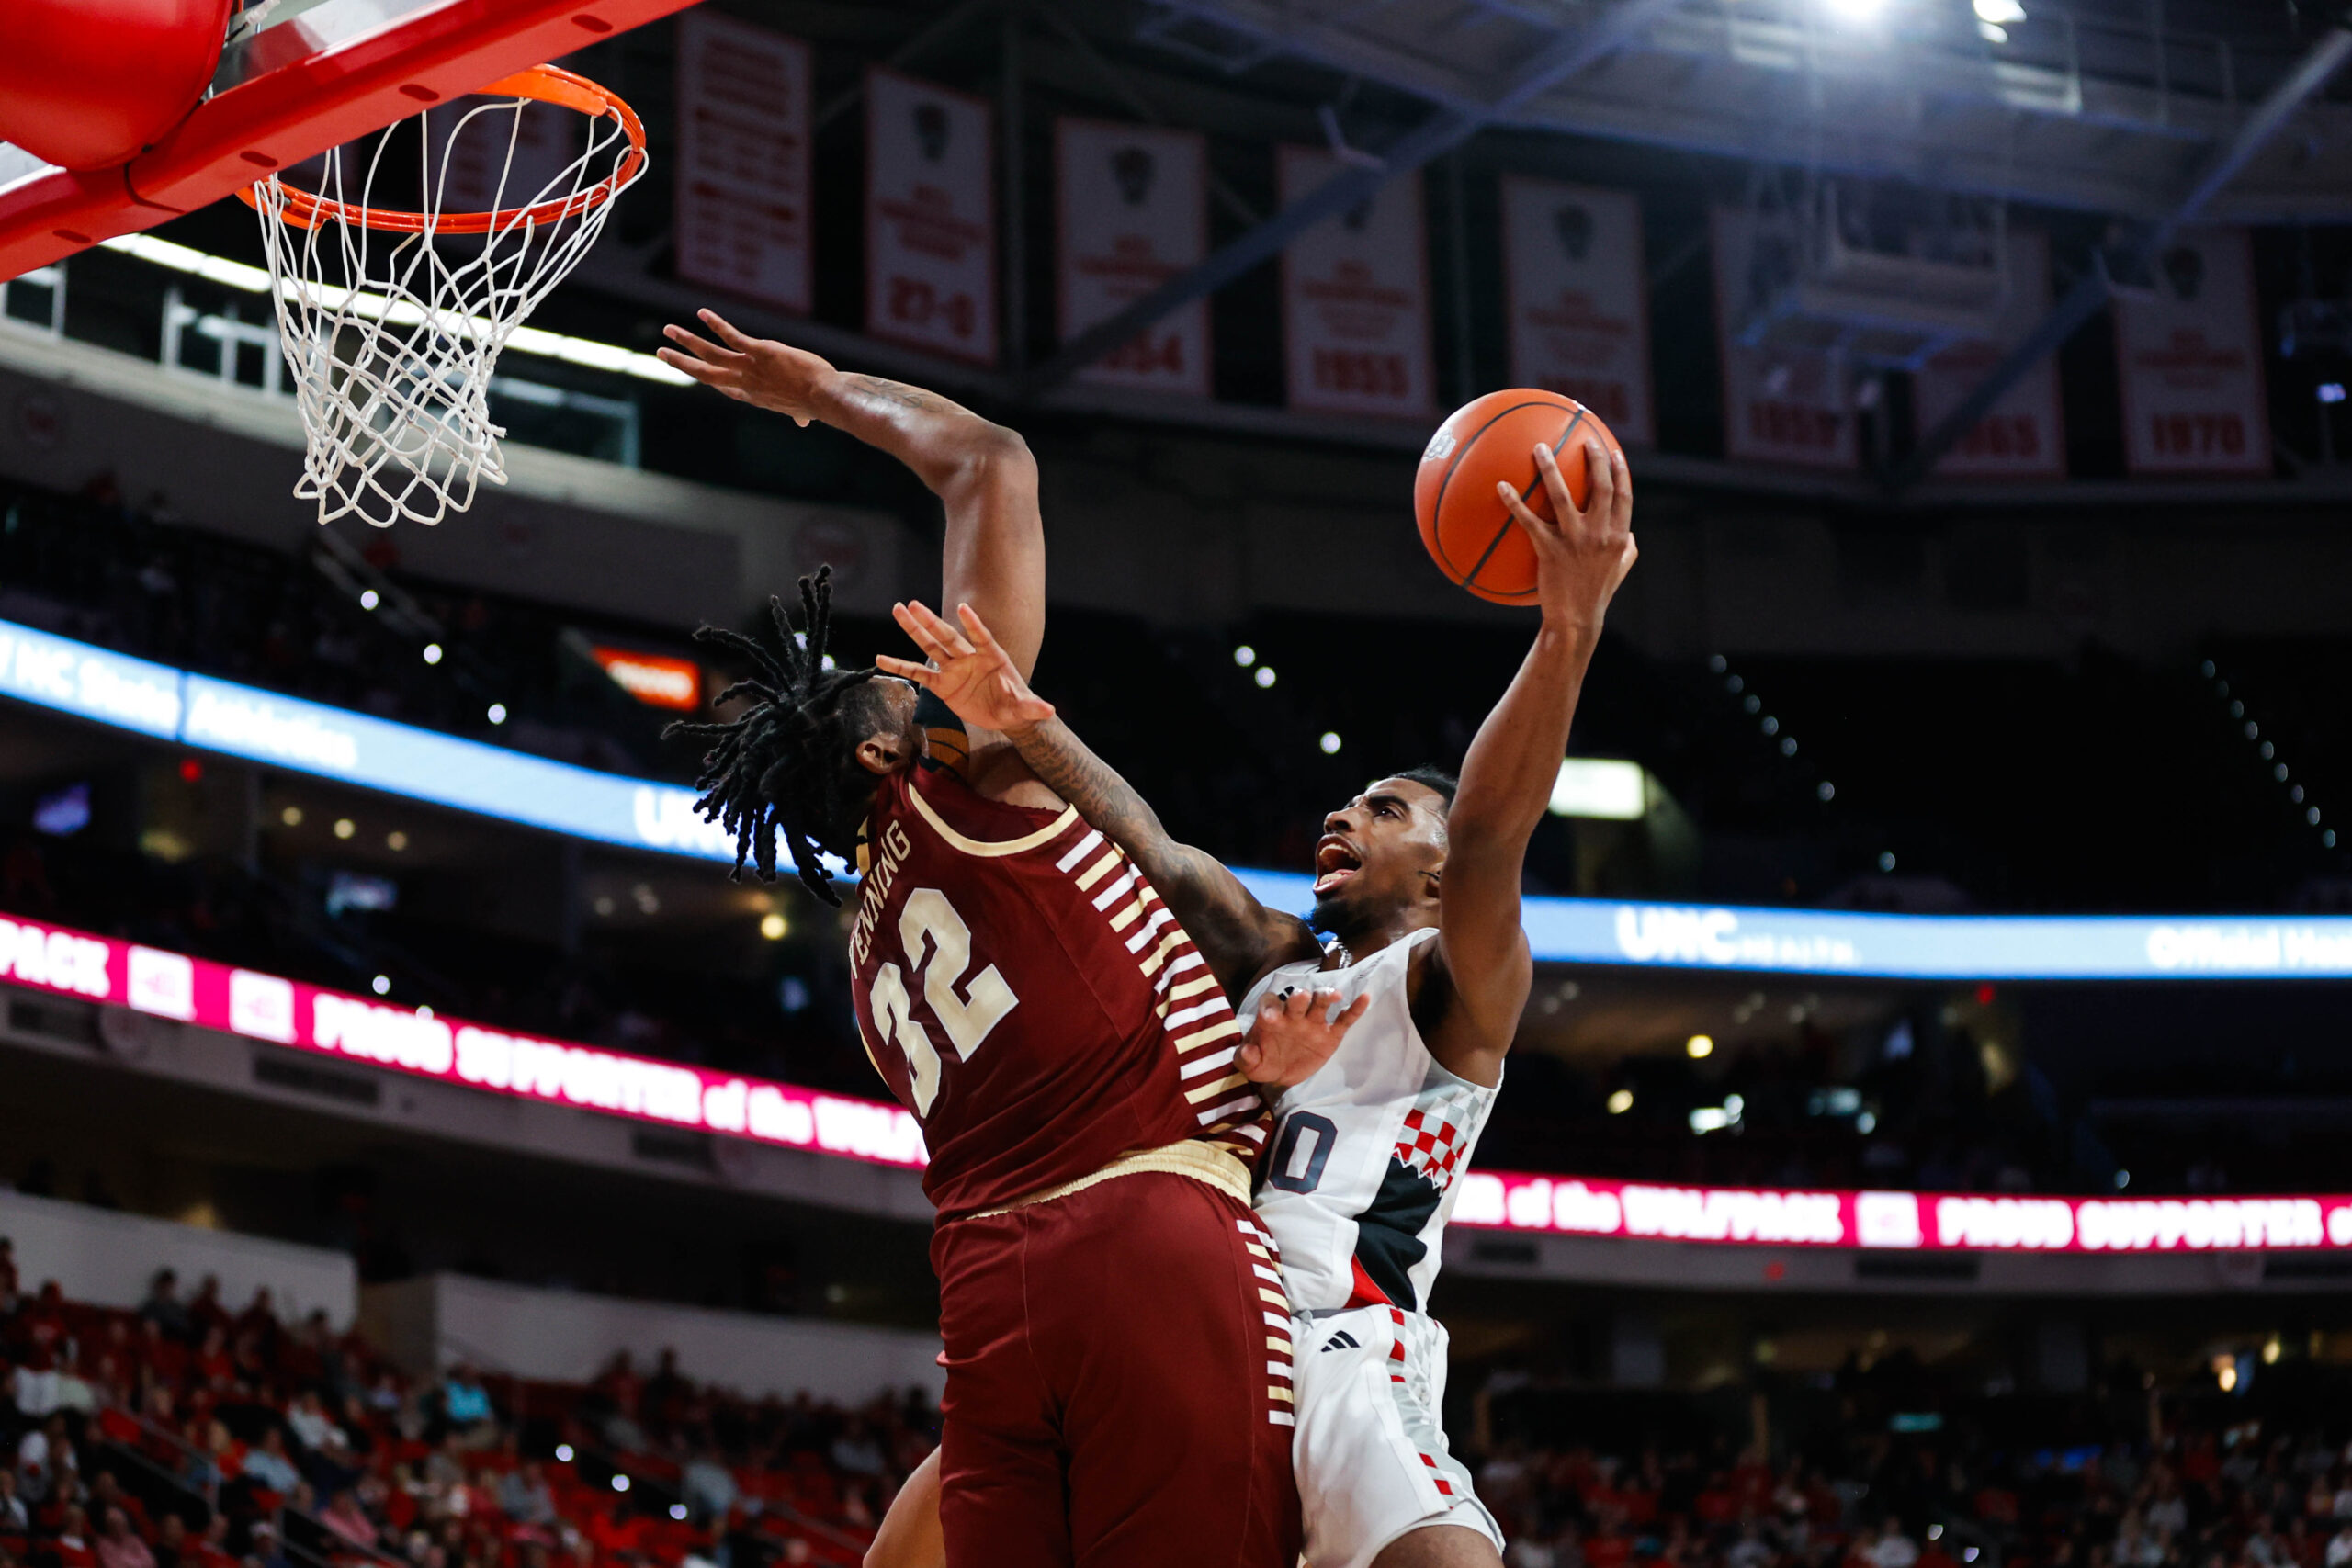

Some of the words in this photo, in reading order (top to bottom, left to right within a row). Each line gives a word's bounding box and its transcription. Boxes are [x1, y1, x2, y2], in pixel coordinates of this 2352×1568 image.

[1616, 908, 1737, 962] UNC
[869, 888, 1020, 1120] 32
[313, 993, 452, 1073] PROUD
[455, 1027, 702, 1122] SUPPORTER
[704, 1080, 746, 1133] of
[748, 1088, 813, 1145] the
[1508, 1182, 1552, 1225] of
[1553, 1185, 1621, 1231] the
[1623, 1188, 1843, 1242] WOLFPACK
[1938, 1198, 2074, 1247] PROUD
[2077, 1200, 2324, 1248] SUPPORTER
